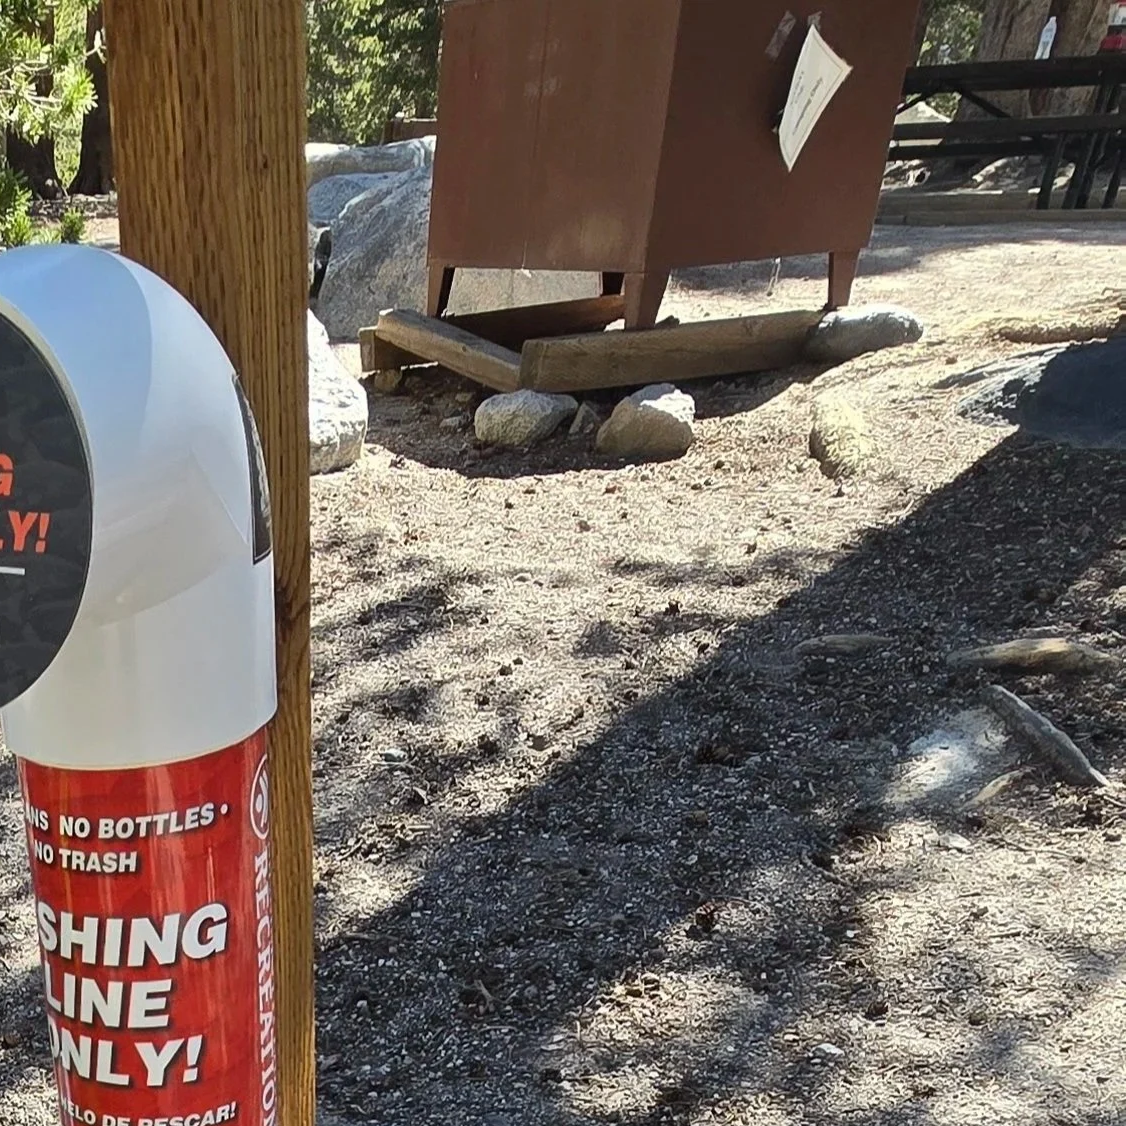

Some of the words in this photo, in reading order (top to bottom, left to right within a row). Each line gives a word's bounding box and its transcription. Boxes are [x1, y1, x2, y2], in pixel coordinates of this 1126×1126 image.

[59, 815, 91, 838] NO
[98, 802, 215, 839] BOTTLES
[34, 839, 54, 864] NO
[58, 848, 137, 873] TRASH
[38, 902, 228, 967] SHING
[44, 959, 172, 1029] LINE
[47, 1015, 203, 1087] ONLY!
